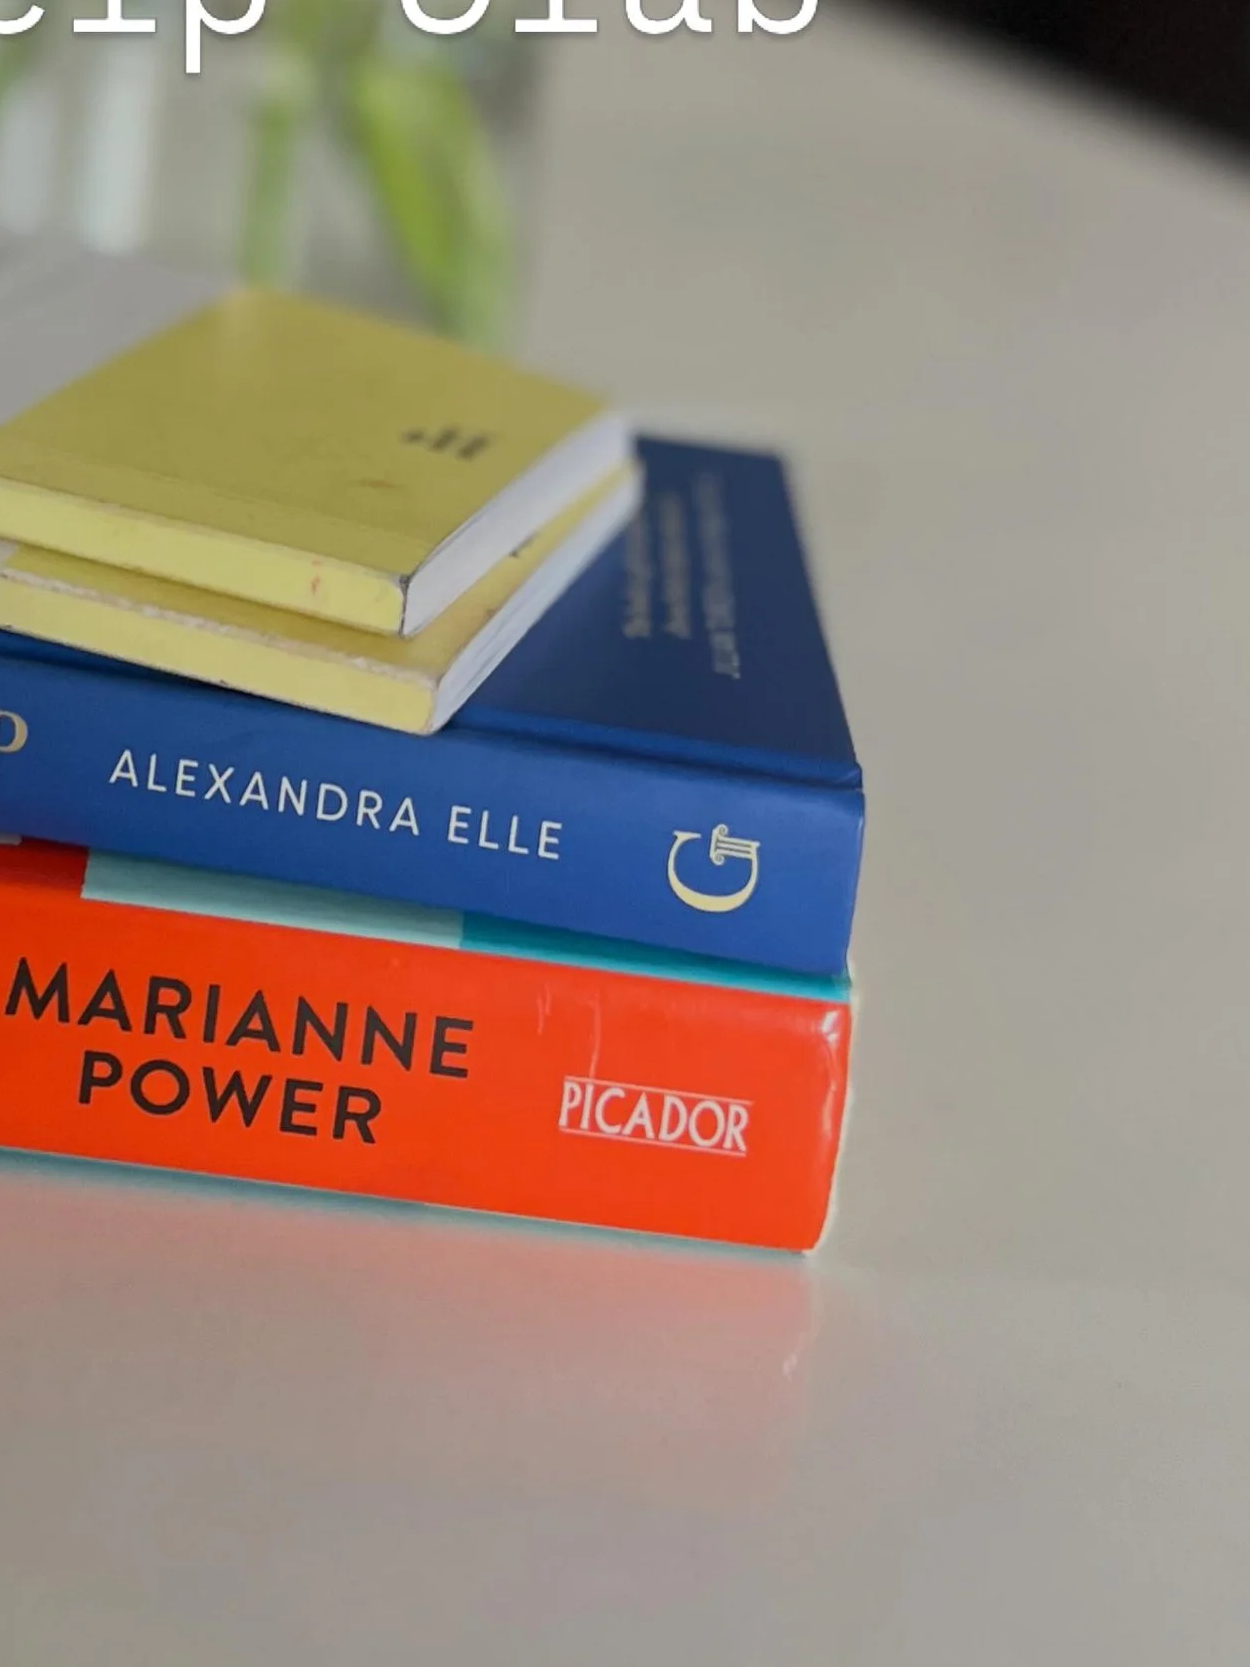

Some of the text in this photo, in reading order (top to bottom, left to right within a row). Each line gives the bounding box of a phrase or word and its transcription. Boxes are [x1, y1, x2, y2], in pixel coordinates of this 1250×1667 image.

[108, 748, 421, 836] ALEXANDRA
[447, 805, 562, 860] ELLE
[3, 956, 475, 1079] MARIANNE
[77, 1049, 382, 1145] POWER
[557, 1079, 750, 1156] PICADOR
